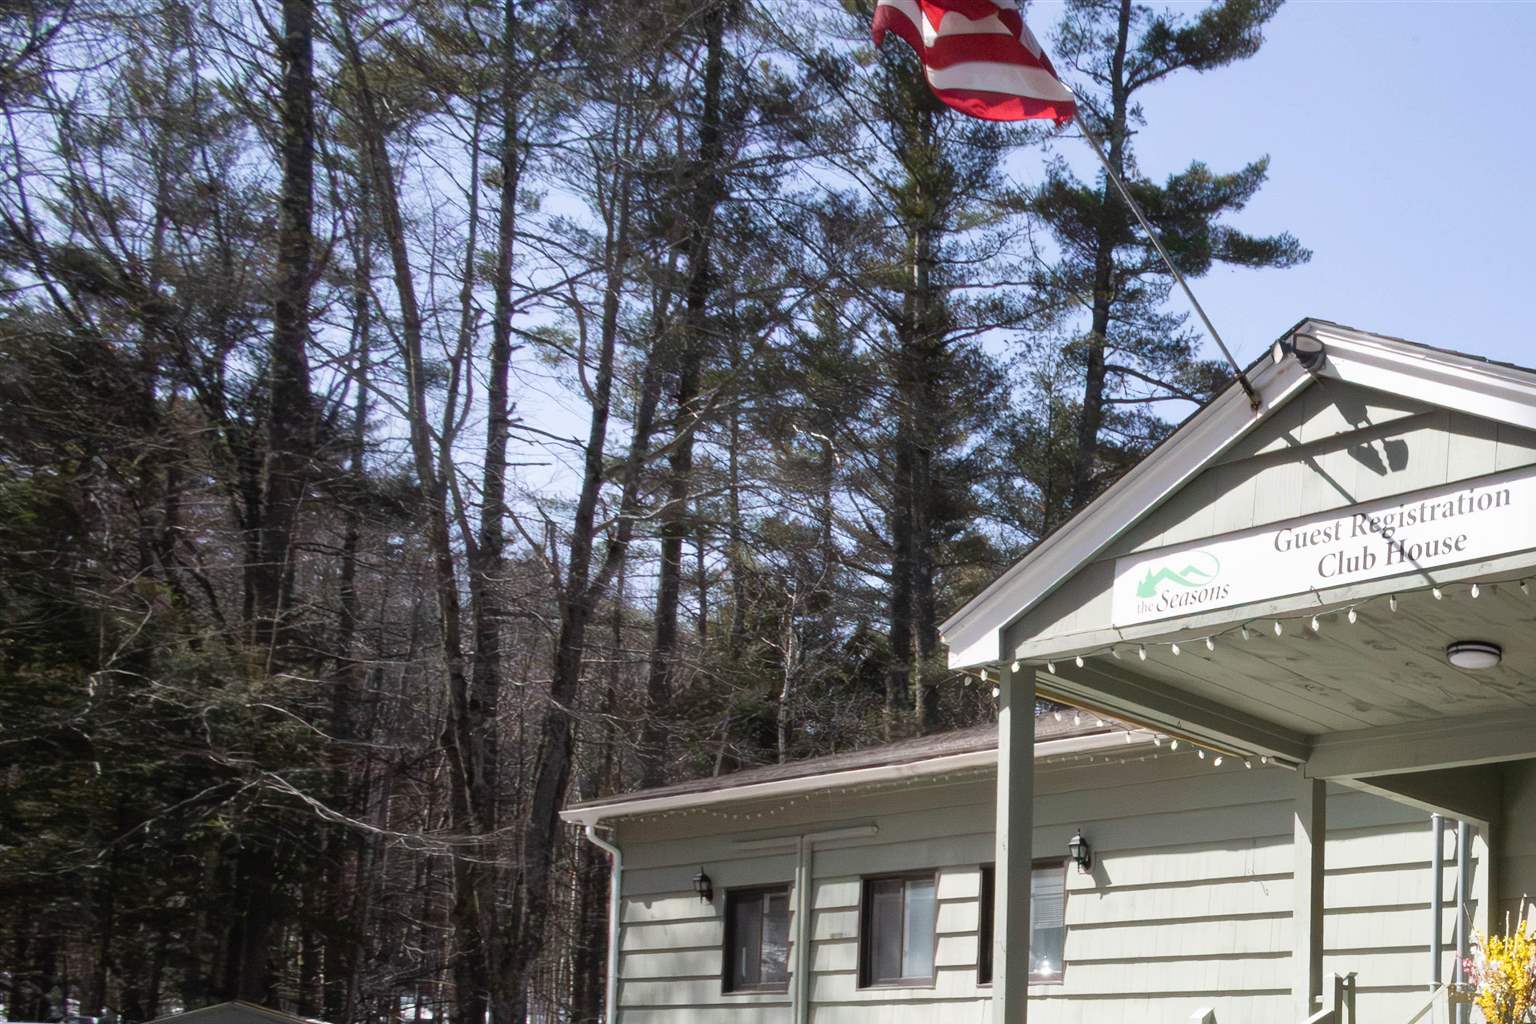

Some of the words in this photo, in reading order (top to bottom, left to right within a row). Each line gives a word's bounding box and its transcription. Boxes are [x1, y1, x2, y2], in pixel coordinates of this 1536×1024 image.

[1274, 519, 1342, 553] Guest
[1351, 487, 1511, 540] Registration
[1317, 544, 1377, 579] Club
[1385, 532, 1468, 567] House
[1137, 600, 1154, 616] the
[1156, 583, 1231, 612] Seasons
